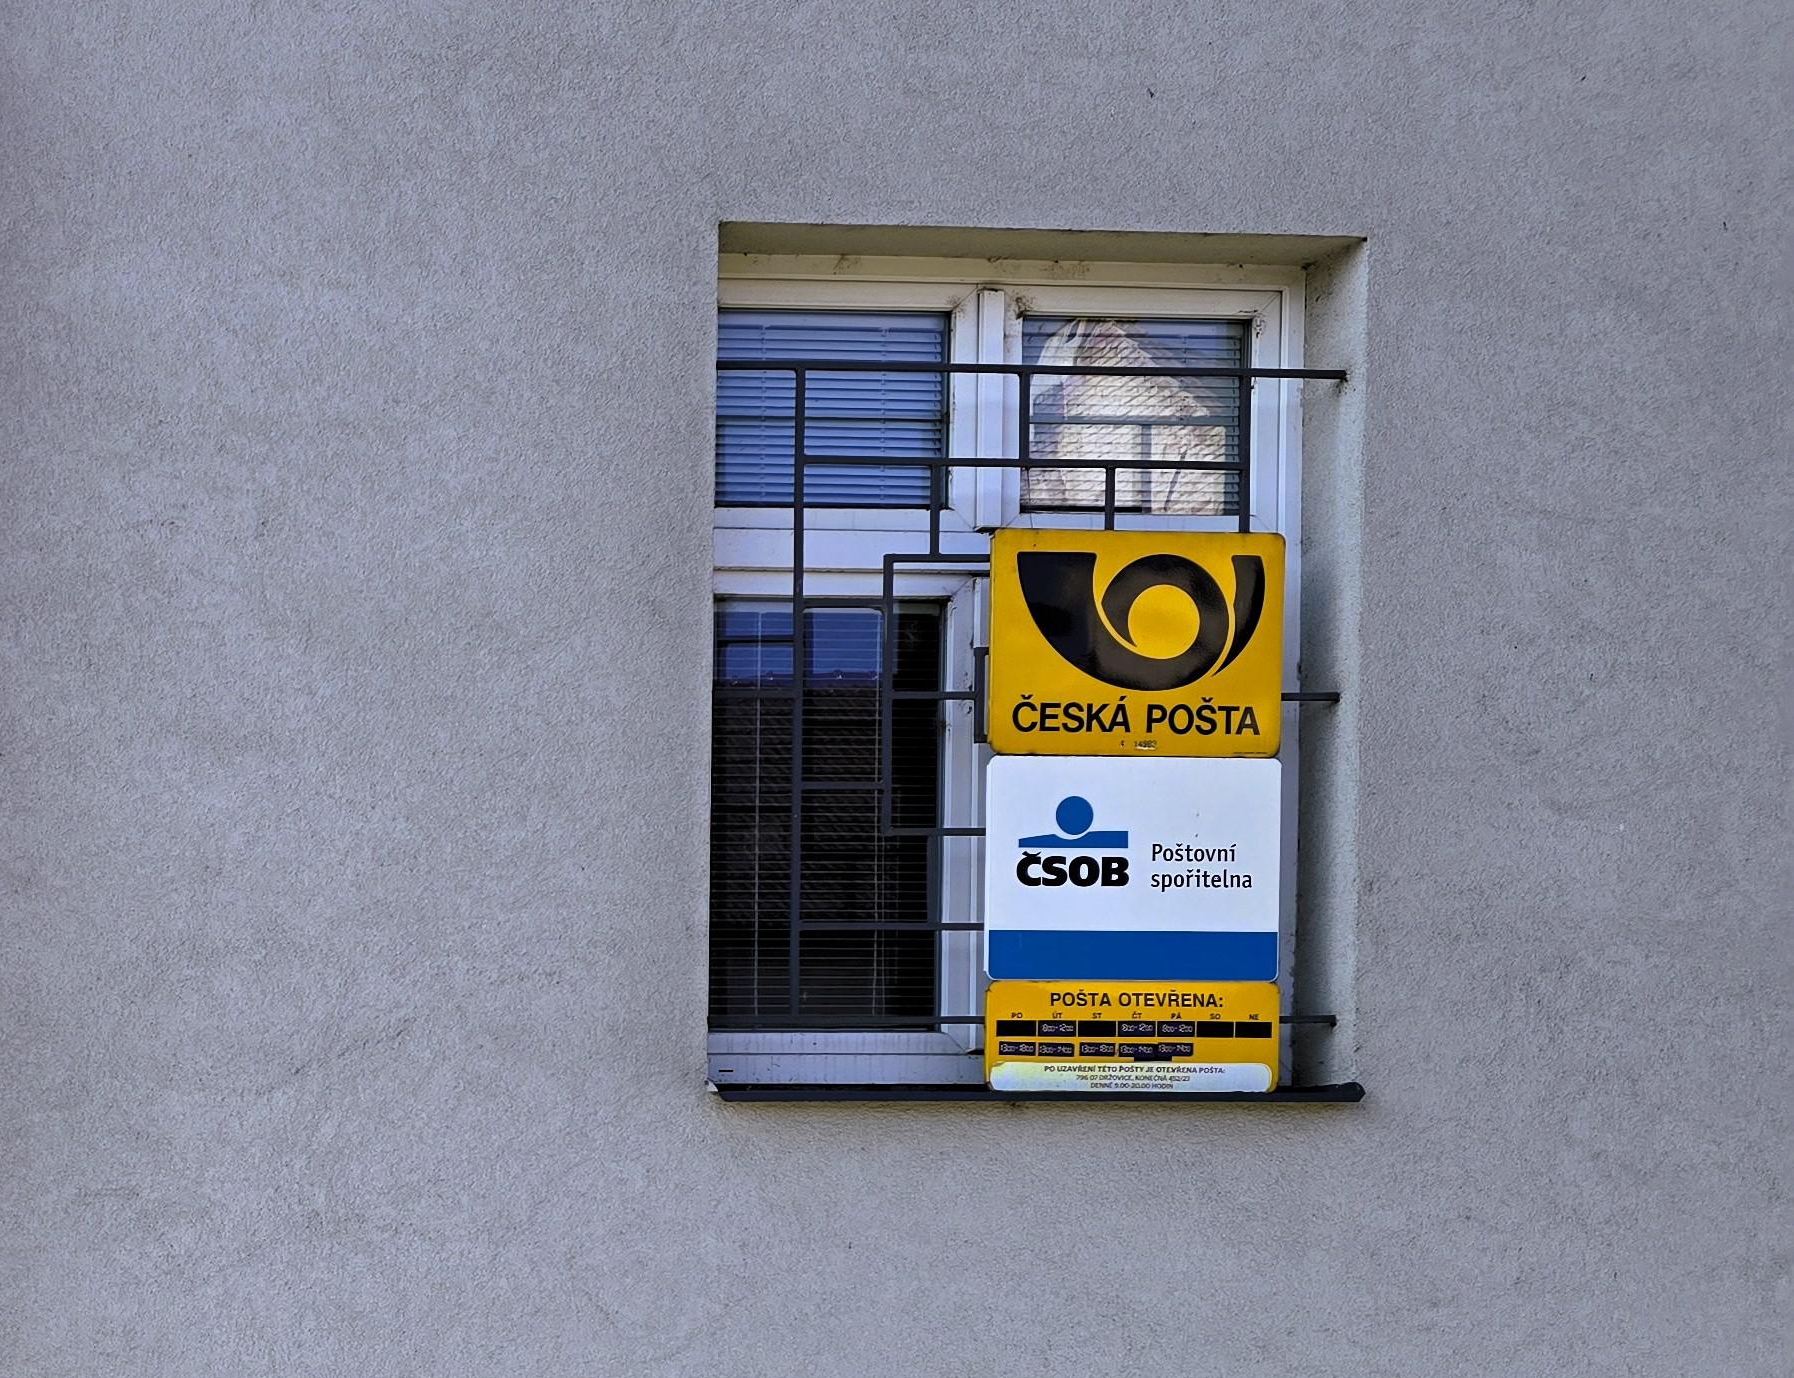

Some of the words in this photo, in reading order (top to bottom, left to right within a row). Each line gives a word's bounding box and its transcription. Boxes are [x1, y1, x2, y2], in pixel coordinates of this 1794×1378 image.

[1012, 695, 1131, 734] ČESKÁ
[1146, 697, 1261, 736] POŠTA
[1151, 842, 1237, 864] Poštovní
[1016, 851, 1130, 888] ČSOB
[1150, 868, 1253, 893] spořitelna
[1050, 989, 1112, 1007] POŠTA
[1118, 990, 1224, 1008] OTEVŘENA:
[1011, 1012, 1023, 1020] PO
[1051, 1011, 1063, 1020] ÚT
[1091, 1012, 1102, 1020] ST
[1131, 1010, 1142, 1020] ČT
[1170, 1011, 1182, 1020] PÁ
[1210, 1012, 1221, 1021] SO
[1248, 1013, 1260, 1021] NE
[1097, 1065, 1117, 1073] TÉTO
[1118, 1065, 1145, 1073] POŠTY
[1156, 1066, 1197, 1074] OTEVŘENA
[1198, 1066, 1225, 1074] POŠTA:
